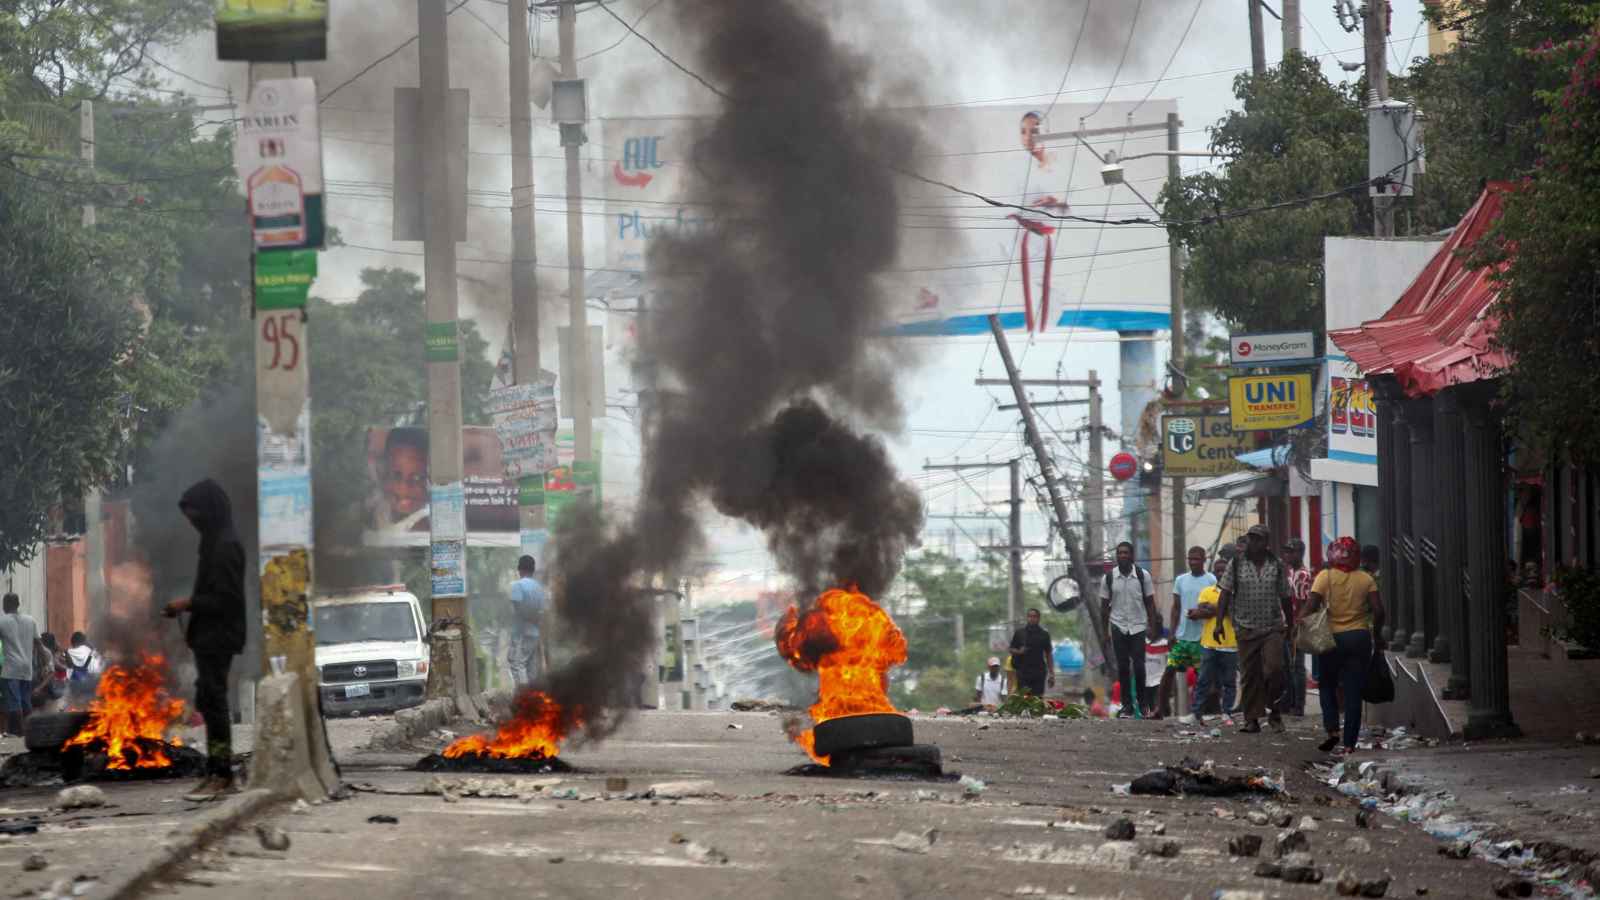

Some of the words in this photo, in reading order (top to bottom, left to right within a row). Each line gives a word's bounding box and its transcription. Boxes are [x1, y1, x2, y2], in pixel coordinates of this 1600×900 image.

[263, 315, 299, 370] 95
[1254, 342, 1307, 352] MoneyGram
[1245, 381, 1296, 403] UNI
[1247, 403, 1296, 412] TRANSFER
[1170, 435, 1192, 453] LC
